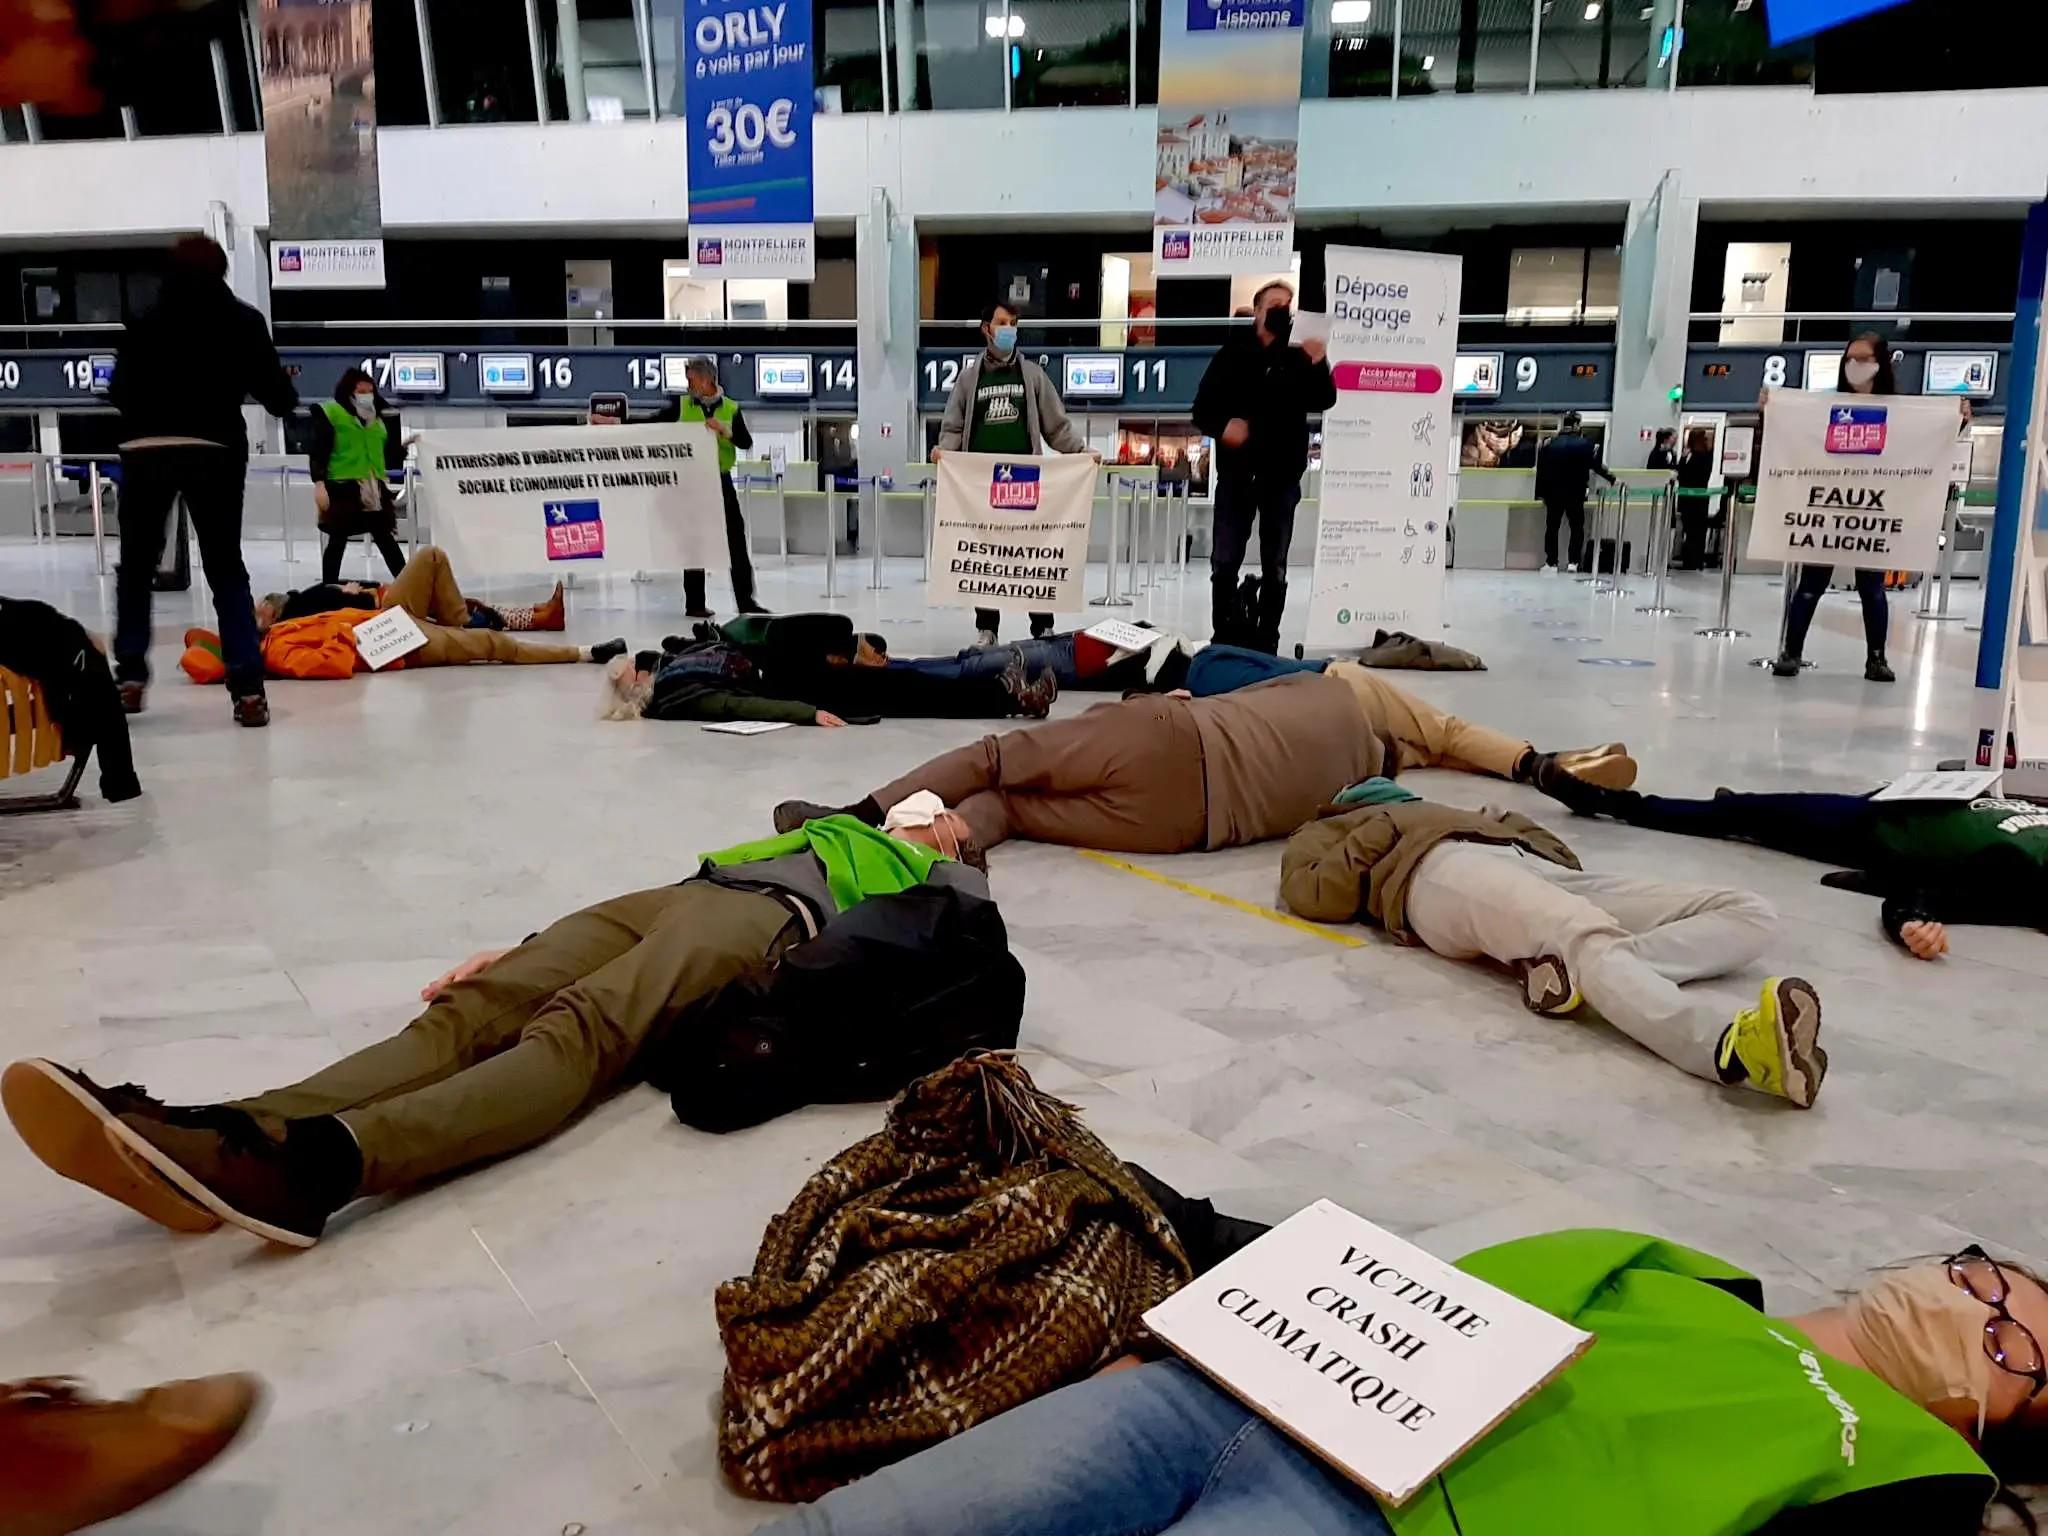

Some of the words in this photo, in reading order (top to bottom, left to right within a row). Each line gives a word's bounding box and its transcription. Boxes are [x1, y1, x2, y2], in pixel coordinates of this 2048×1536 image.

[696, 3, 786, 54] ORLY
[1216, 10, 1291, 31] Lisbonne
[696, 57, 706, 79] 6
[709, 52, 741, 76] vols
[744, 50, 770, 73] par
[773, 43, 806, 69] jour
[706, 98, 797, 154] 30€
[724, 239, 807, 250] MONTPELLIER
[1193, 230, 1285, 243] MONTPELLIER
[303, 247, 376, 258] MONTPELLIER
[1335, 274, 1409, 303] Dépose
[1334, 300, 1411, 330] Bagage
[63, 360, 91, 389] 19
[360, 357, 393, 389] 17
[538, 356, 573, 389] 16
[627, 358, 662, 390] 15
[819, 358, 857, 391] 14
[924, 359, 958, 392] 12
[1132, 359, 1167, 392] 11
[1360, 366, 1384, 377] Accès
[1515, 356, 1539, 393] 9
[1763, 355, 1786, 387] 8
[1833, 425, 1881, 440] SOS
[436, 452, 520, 470] ATTERRISSONS
[521, 448, 585, 466] D'URGENCE
[586, 448, 620, 462] POUR
[620, 446, 645, 461] UNE
[645, 443, 693, 459] JUSTICE
[586, 474, 599, 487] ET
[600, 471, 672, 487] CLIMATIQUE
[1768, 468, 1795, 478] Ligne
[1797, 468, 1841, 477] aérienne
[1843, 467, 1869, 477] Paris
[1873, 466, 1933, 478] Montpellier
[1808, 486, 1885, 511] FAUX
[550, 522, 600, 550] SOS
[939, 520, 977, 529] Extension
[978, 522, 988, 530] de
[1029, 523, 1040, 531] de
[1041, 521, 1086, 531] Montpellier
[1784, 512, 1825, 528] SUR
[1832, 515, 1903, 533] TOUTE
[957, 540, 1064, 560] DESTINATION
[1789, 532, 1815, 548] LA
[1822, 534, 1890, 553] LIGNE.
[950, 557, 1069, 581] DÉRÈGLEMENT
[958, 579, 1057, 600] CLIMATIQUE
[1339, 1246, 1490, 1338] VICTIME
[1306, 1286, 1429, 1361] CRASH
[1217, 1287, 1436, 1432] CLIMATIQUE
